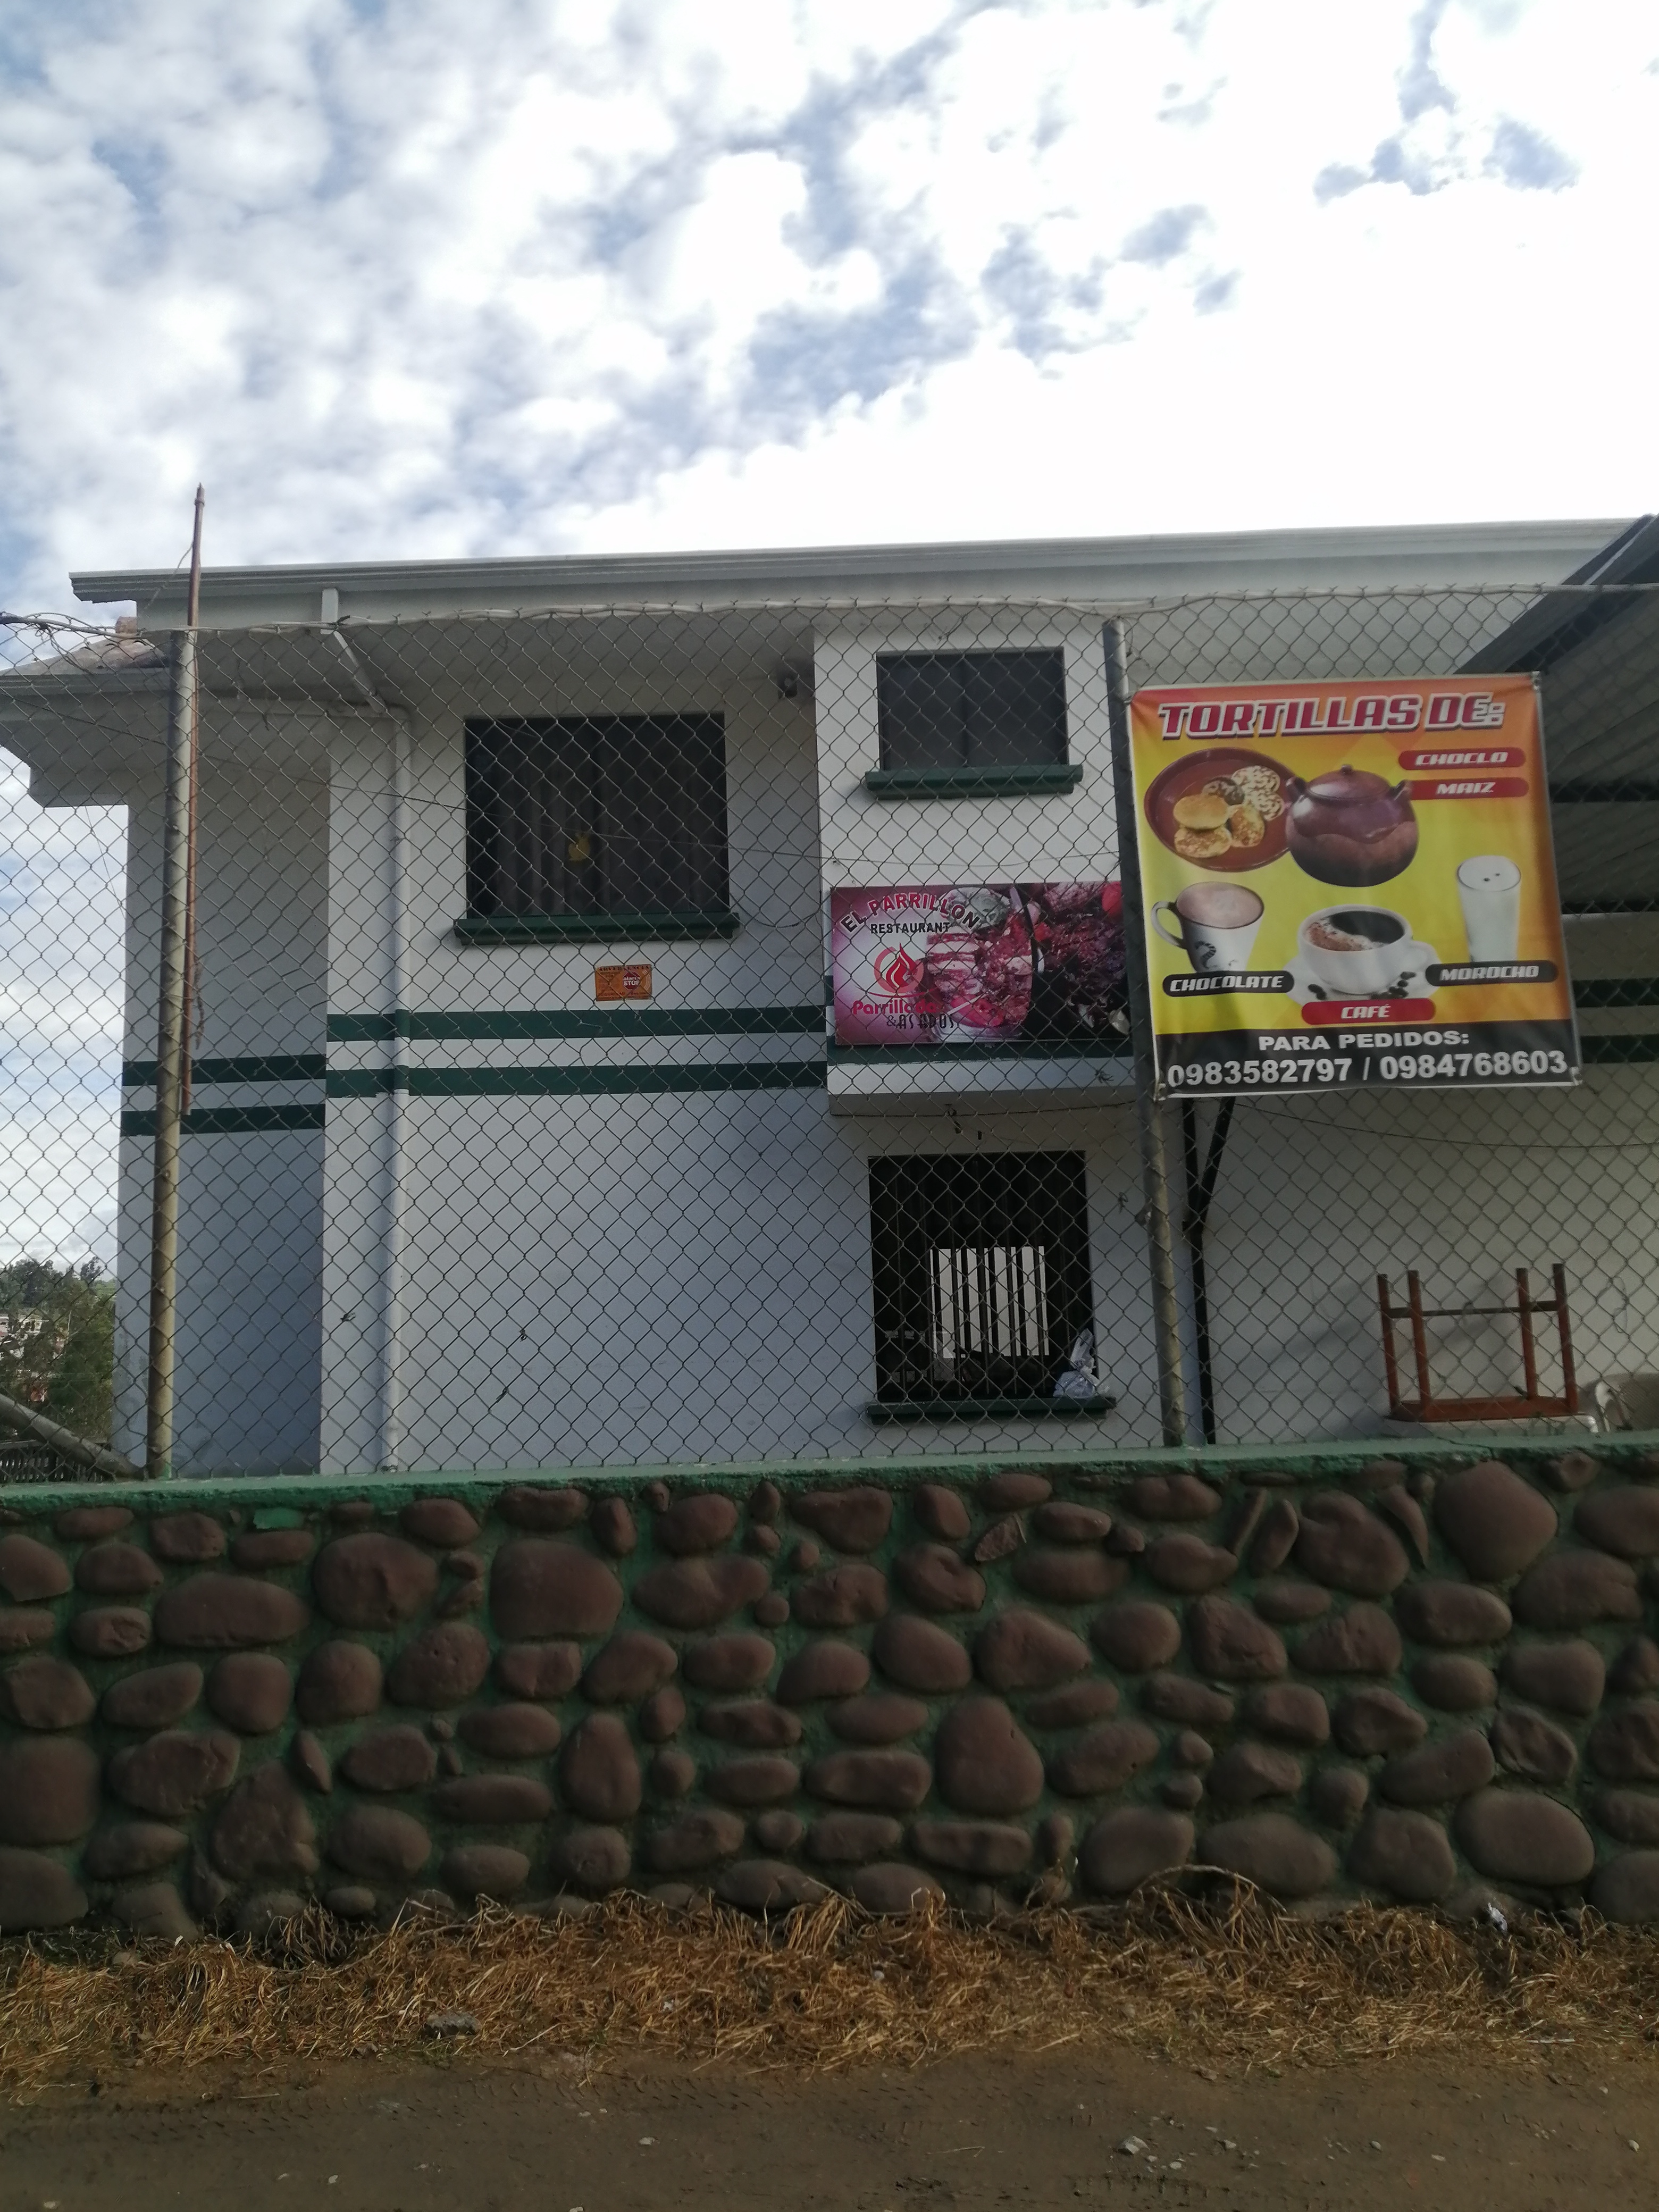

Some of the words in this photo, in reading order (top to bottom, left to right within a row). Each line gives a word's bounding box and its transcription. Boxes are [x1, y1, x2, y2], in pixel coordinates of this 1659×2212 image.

[1159, 694, 1423, 740] TORTILLAS
[1414, 752, 1509, 766] CHOCLO
[1436, 782, 1496, 795] MAIZ
[840, 910, 867, 932] EL
[868, 893, 981, 929] PARRILLON
[870, 921, 950, 934] RESTAURANT
[1439, 965, 1539, 982] MOROCHO
[1170, 975, 1284, 993] CHOCOLATE
[853, 999, 944, 1015] Parrillada
[1341, 1003, 1391, 1019] CAFÉ
[1259, 1035, 1330, 1051] PARA
[1339, 1030, 1469, 1049] PEDIDOS:
[1167, 1058, 1352, 1087] 0983582797
[1380, 1050, 1568, 1080] 0984768603
